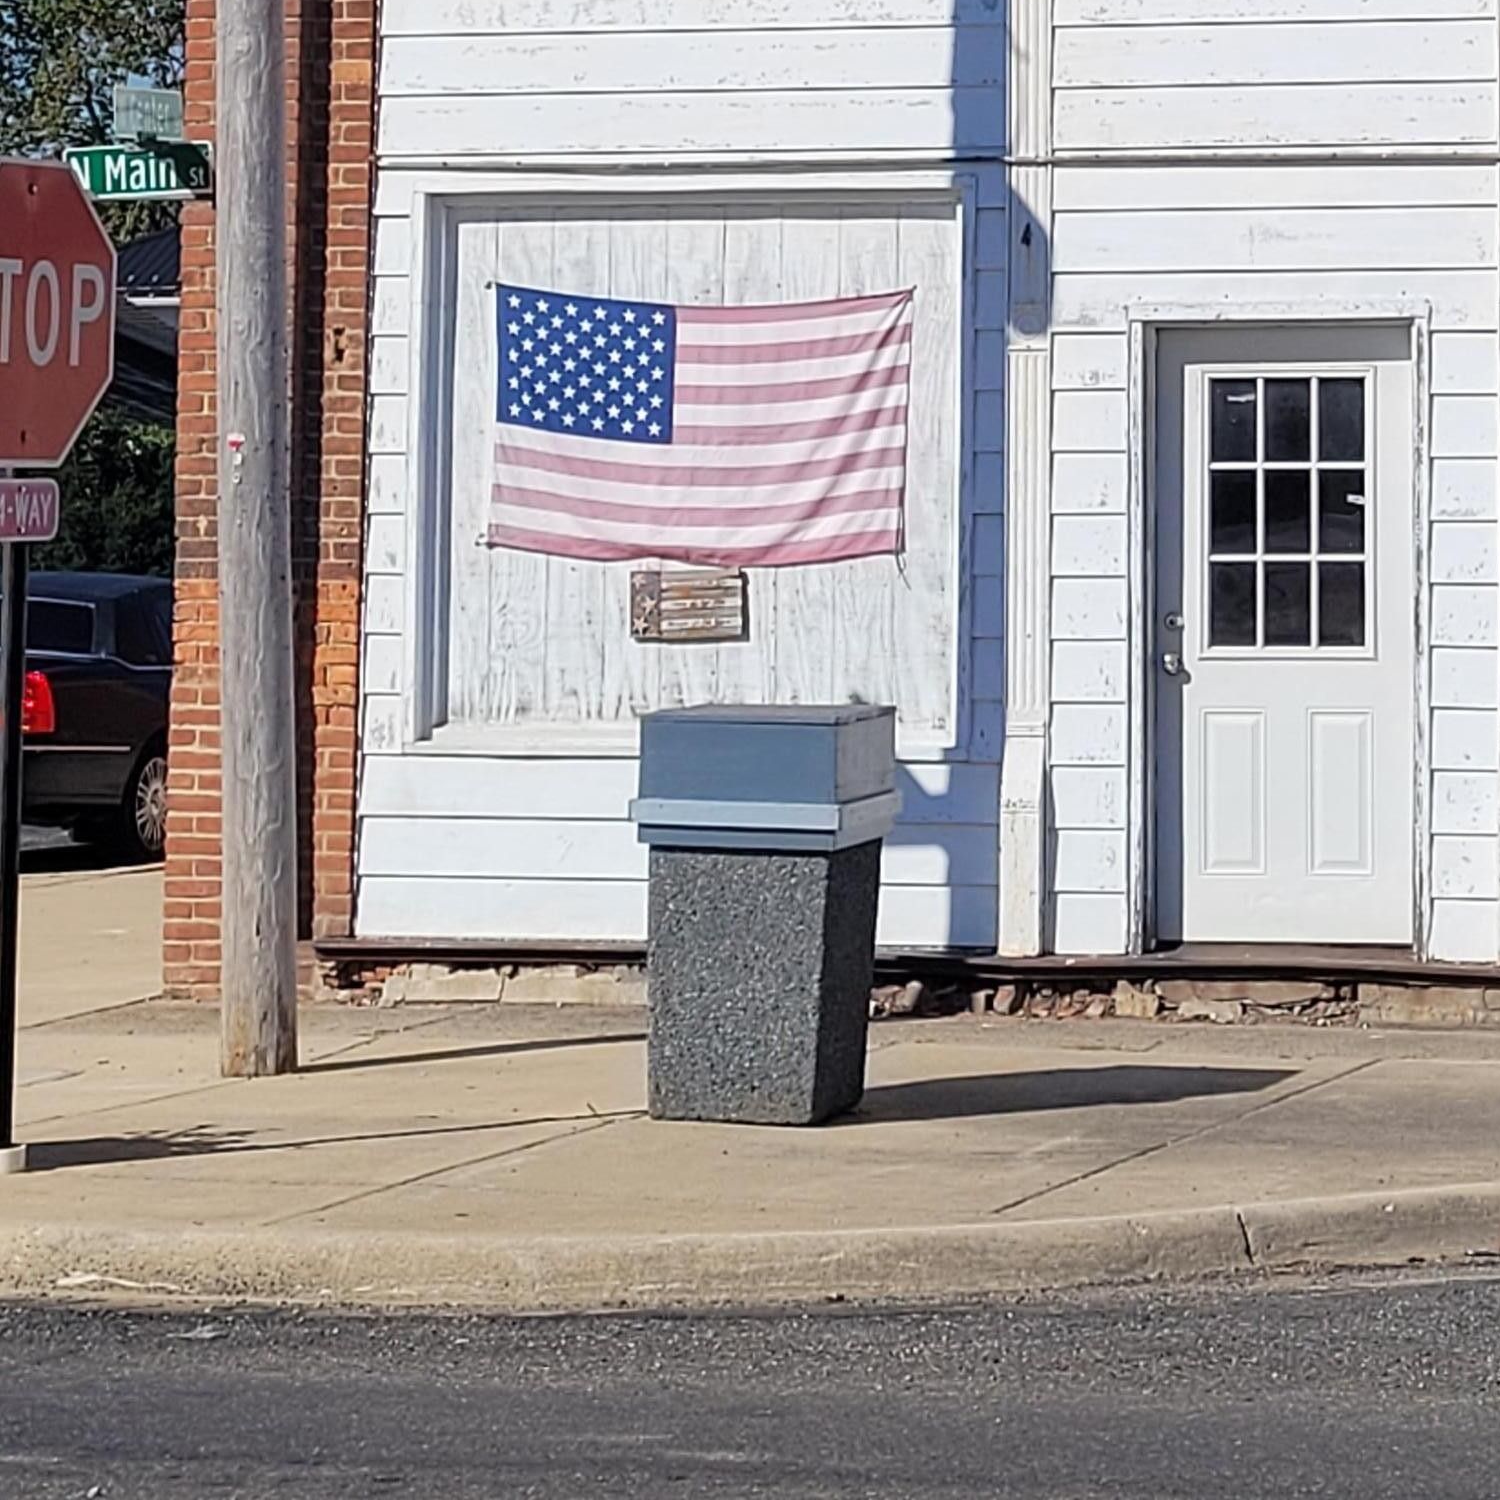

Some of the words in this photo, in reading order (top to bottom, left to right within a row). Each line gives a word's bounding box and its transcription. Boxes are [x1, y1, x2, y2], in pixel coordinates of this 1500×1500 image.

[70, 156, 91, 191] N
[105, 152, 177, 191] Main
[189, 167, 205, 186] St
